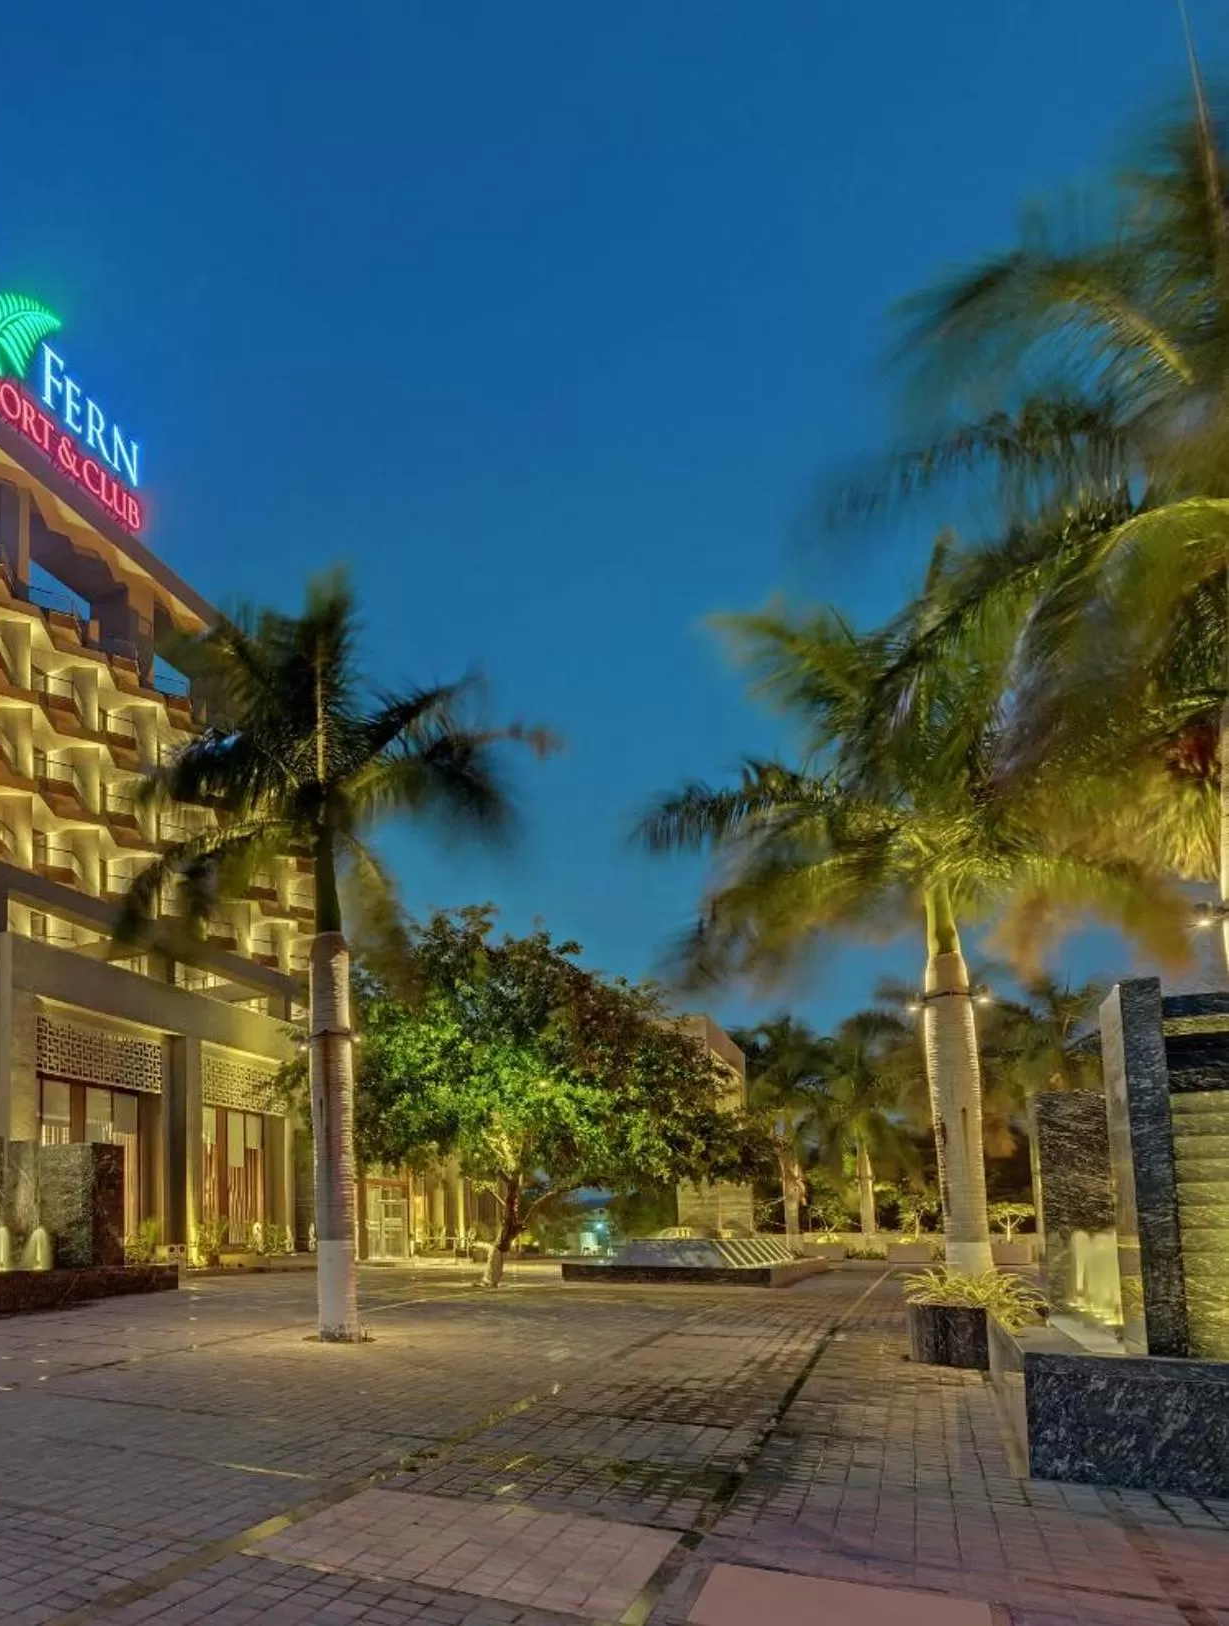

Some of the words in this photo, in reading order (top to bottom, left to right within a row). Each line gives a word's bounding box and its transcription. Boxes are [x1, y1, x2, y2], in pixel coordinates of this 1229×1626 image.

[41, 342, 140, 487] FERN
[57, 434, 81, 478] &
[82, 459, 141, 530] CLUB
